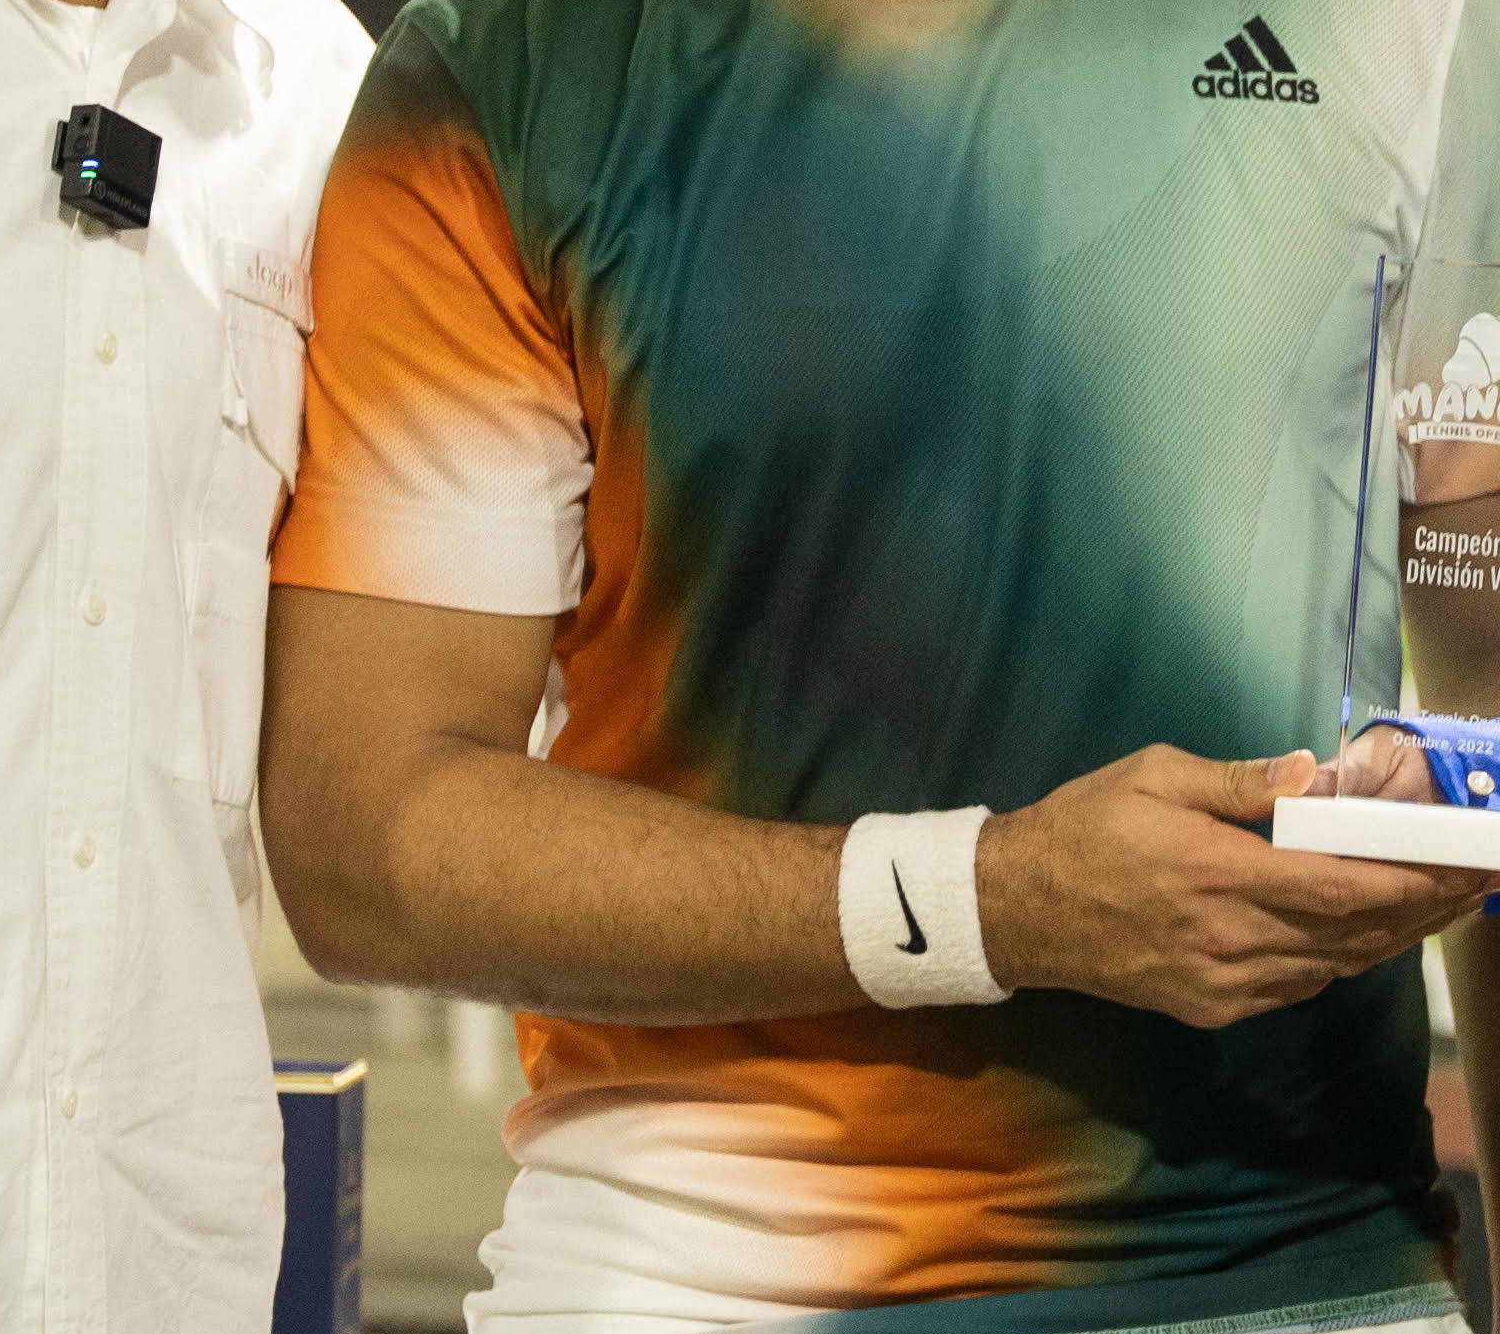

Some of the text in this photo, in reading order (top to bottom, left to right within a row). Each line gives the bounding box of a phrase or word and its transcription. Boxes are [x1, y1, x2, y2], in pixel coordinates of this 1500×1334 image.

[1191, 68, 1321, 105] adidas
[1425, 424, 1471, 437] TENNIS
[1405, 557, 1485, 590] División
[1368, 705, 1414, 725] Man
[1392, 731, 1495, 755] Octubre, 2022
